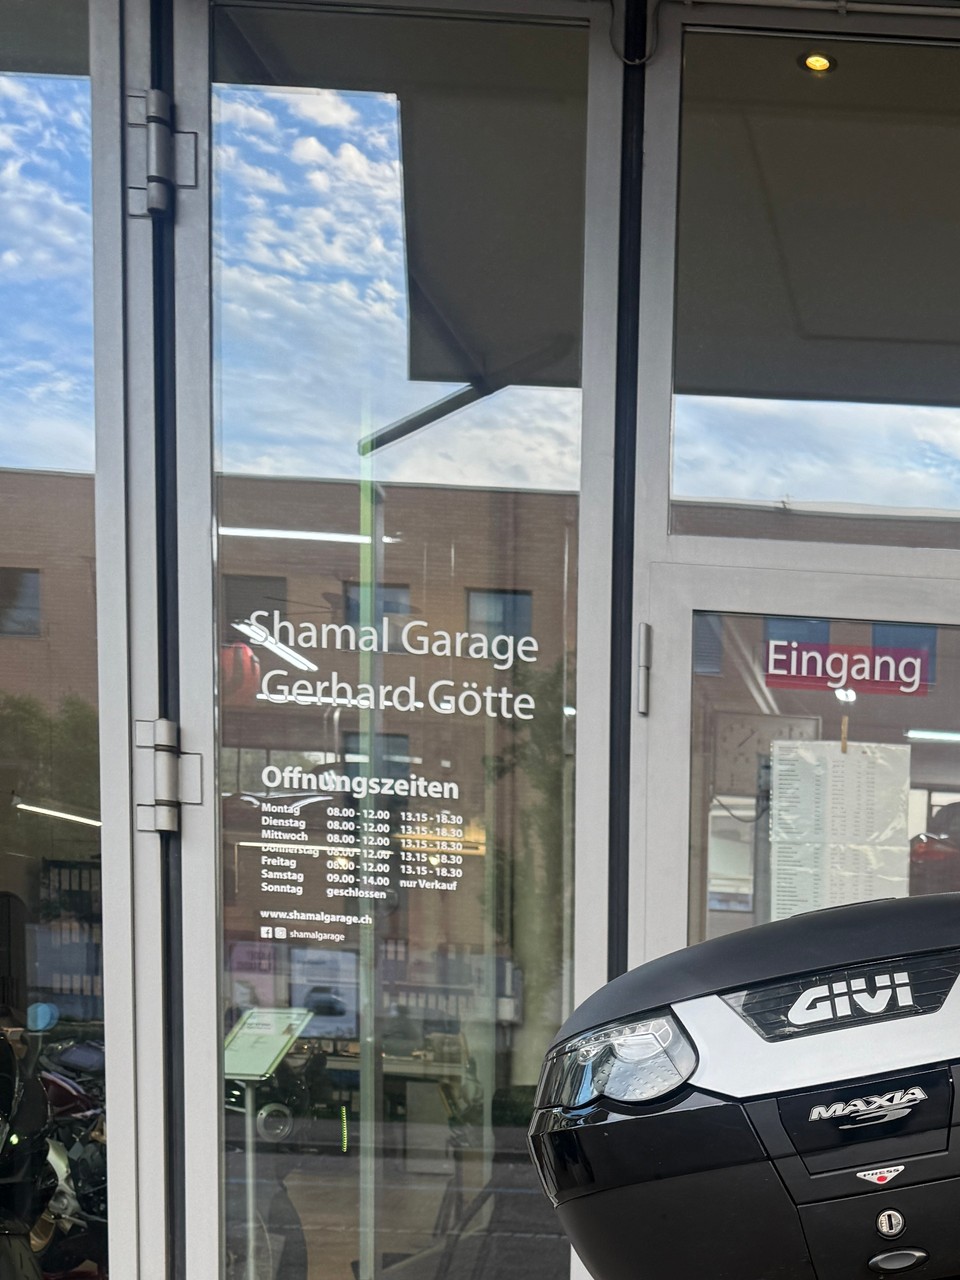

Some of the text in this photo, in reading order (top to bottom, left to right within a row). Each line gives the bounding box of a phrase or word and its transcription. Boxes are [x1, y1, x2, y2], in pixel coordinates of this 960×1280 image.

[249, 610, 539, 670] Shamal Garage
[767, 640, 922, 692] Eingang
[261, 669, 536, 720] Gerhard Götte
[261, 803, 301, 816] Montag
[327, 807, 355, 817] 08.00
[362, 810, 390, 820] 12.00
[400, 812, 428, 822] 13.15
[436, 814, 463, 824] 18.30
[261, 816, 306, 830] Dienstag
[327, 820, 355, 830] 08.00
[362, 823, 390, 833] 12.00
[400, 825, 428, 835] 13.15
[436, 827, 463, 837] 18.30
[261, 829, 308, 842] Mittwoch
[327, 834, 355, 844] 08.00
[362, 836, 390, 846] 12.00
[400, 839, 428, 848] 13.15
[436, 841, 463, 851] 18.30
[261, 856, 297, 869] Freitag
[362, 863, 390, 873] 12.00
[400, 865, 428, 875] 13.15
[436, 867, 463, 877] 18.30
[362, 850, 390, 860] 12.00
[400, 852, 428, 862] 13.15
[436, 854, 463, 864] 18.30
[261, 869, 304, 882] Samstag
[327, 873, 355, 884] 09.00
[362, 876, 390, 886] 14.00
[400, 880, 417, 888] nur
[419, 879, 458, 891] Verkauf
[261, 882, 387, 899] Sonntag geschlossen
[260, 909, 373, 925] www.shamalgarage.ch
[289, 930, 345, 942] shamalgarage
[787, 971, 914, 1026] GIVI
[808, 1085, 929, 1121] MAXIA
[863, 1167, 900, 1177] PRESS
